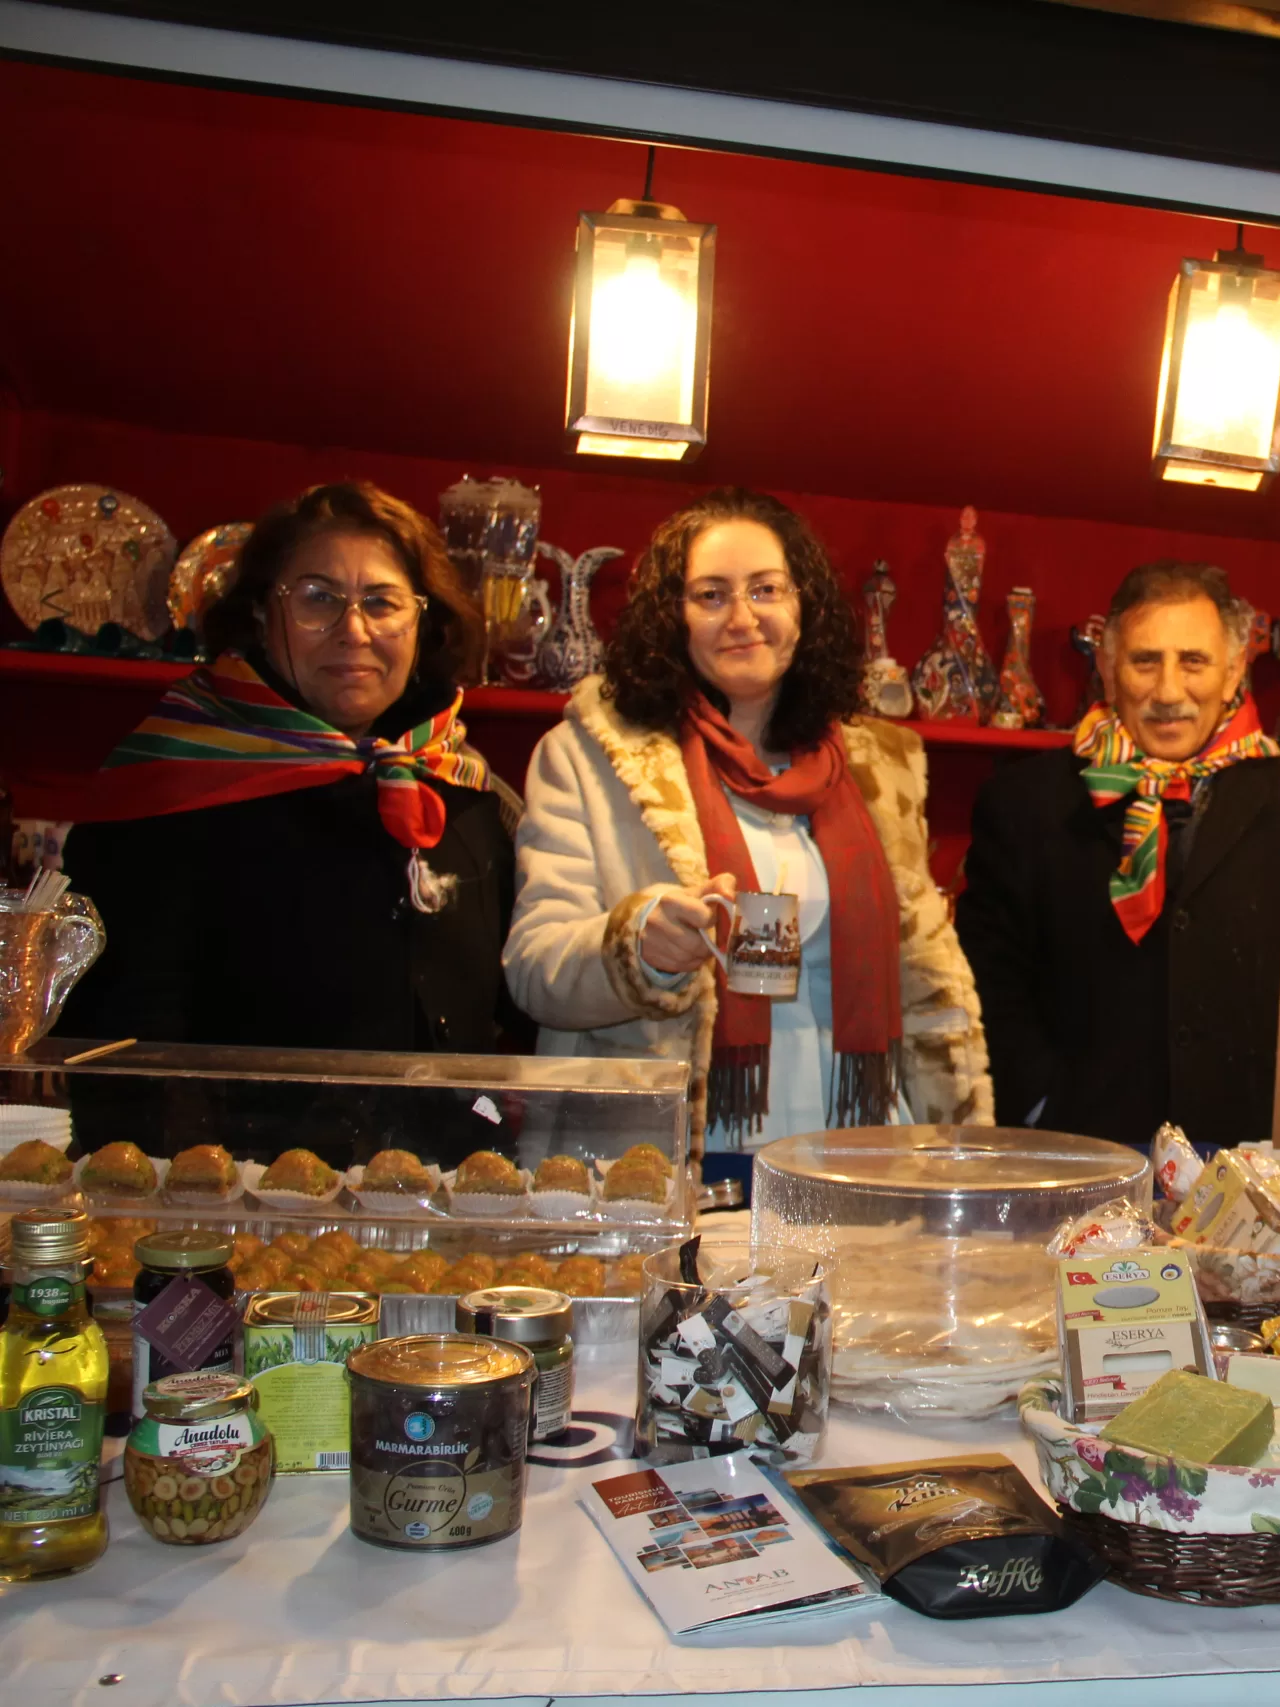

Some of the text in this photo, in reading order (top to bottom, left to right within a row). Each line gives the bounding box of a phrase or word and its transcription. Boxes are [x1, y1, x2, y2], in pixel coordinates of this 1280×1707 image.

[1105, 1271, 1147, 1281] ESERYA
[29, 1288, 60, 1298] 1938
[1111, 1327, 1165, 1342] ESERYA
[174, 1423, 240, 1447] Anadolu
[375, 1439, 469, 1456] MARMARABİRLİK
[387, 1490, 458, 1513] Gurme
[608, 1485, 666, 1503] TOURISMUS
[614, 1490, 665, 1505] PARADIES
[704, 1568, 790, 1594] ANTAB
